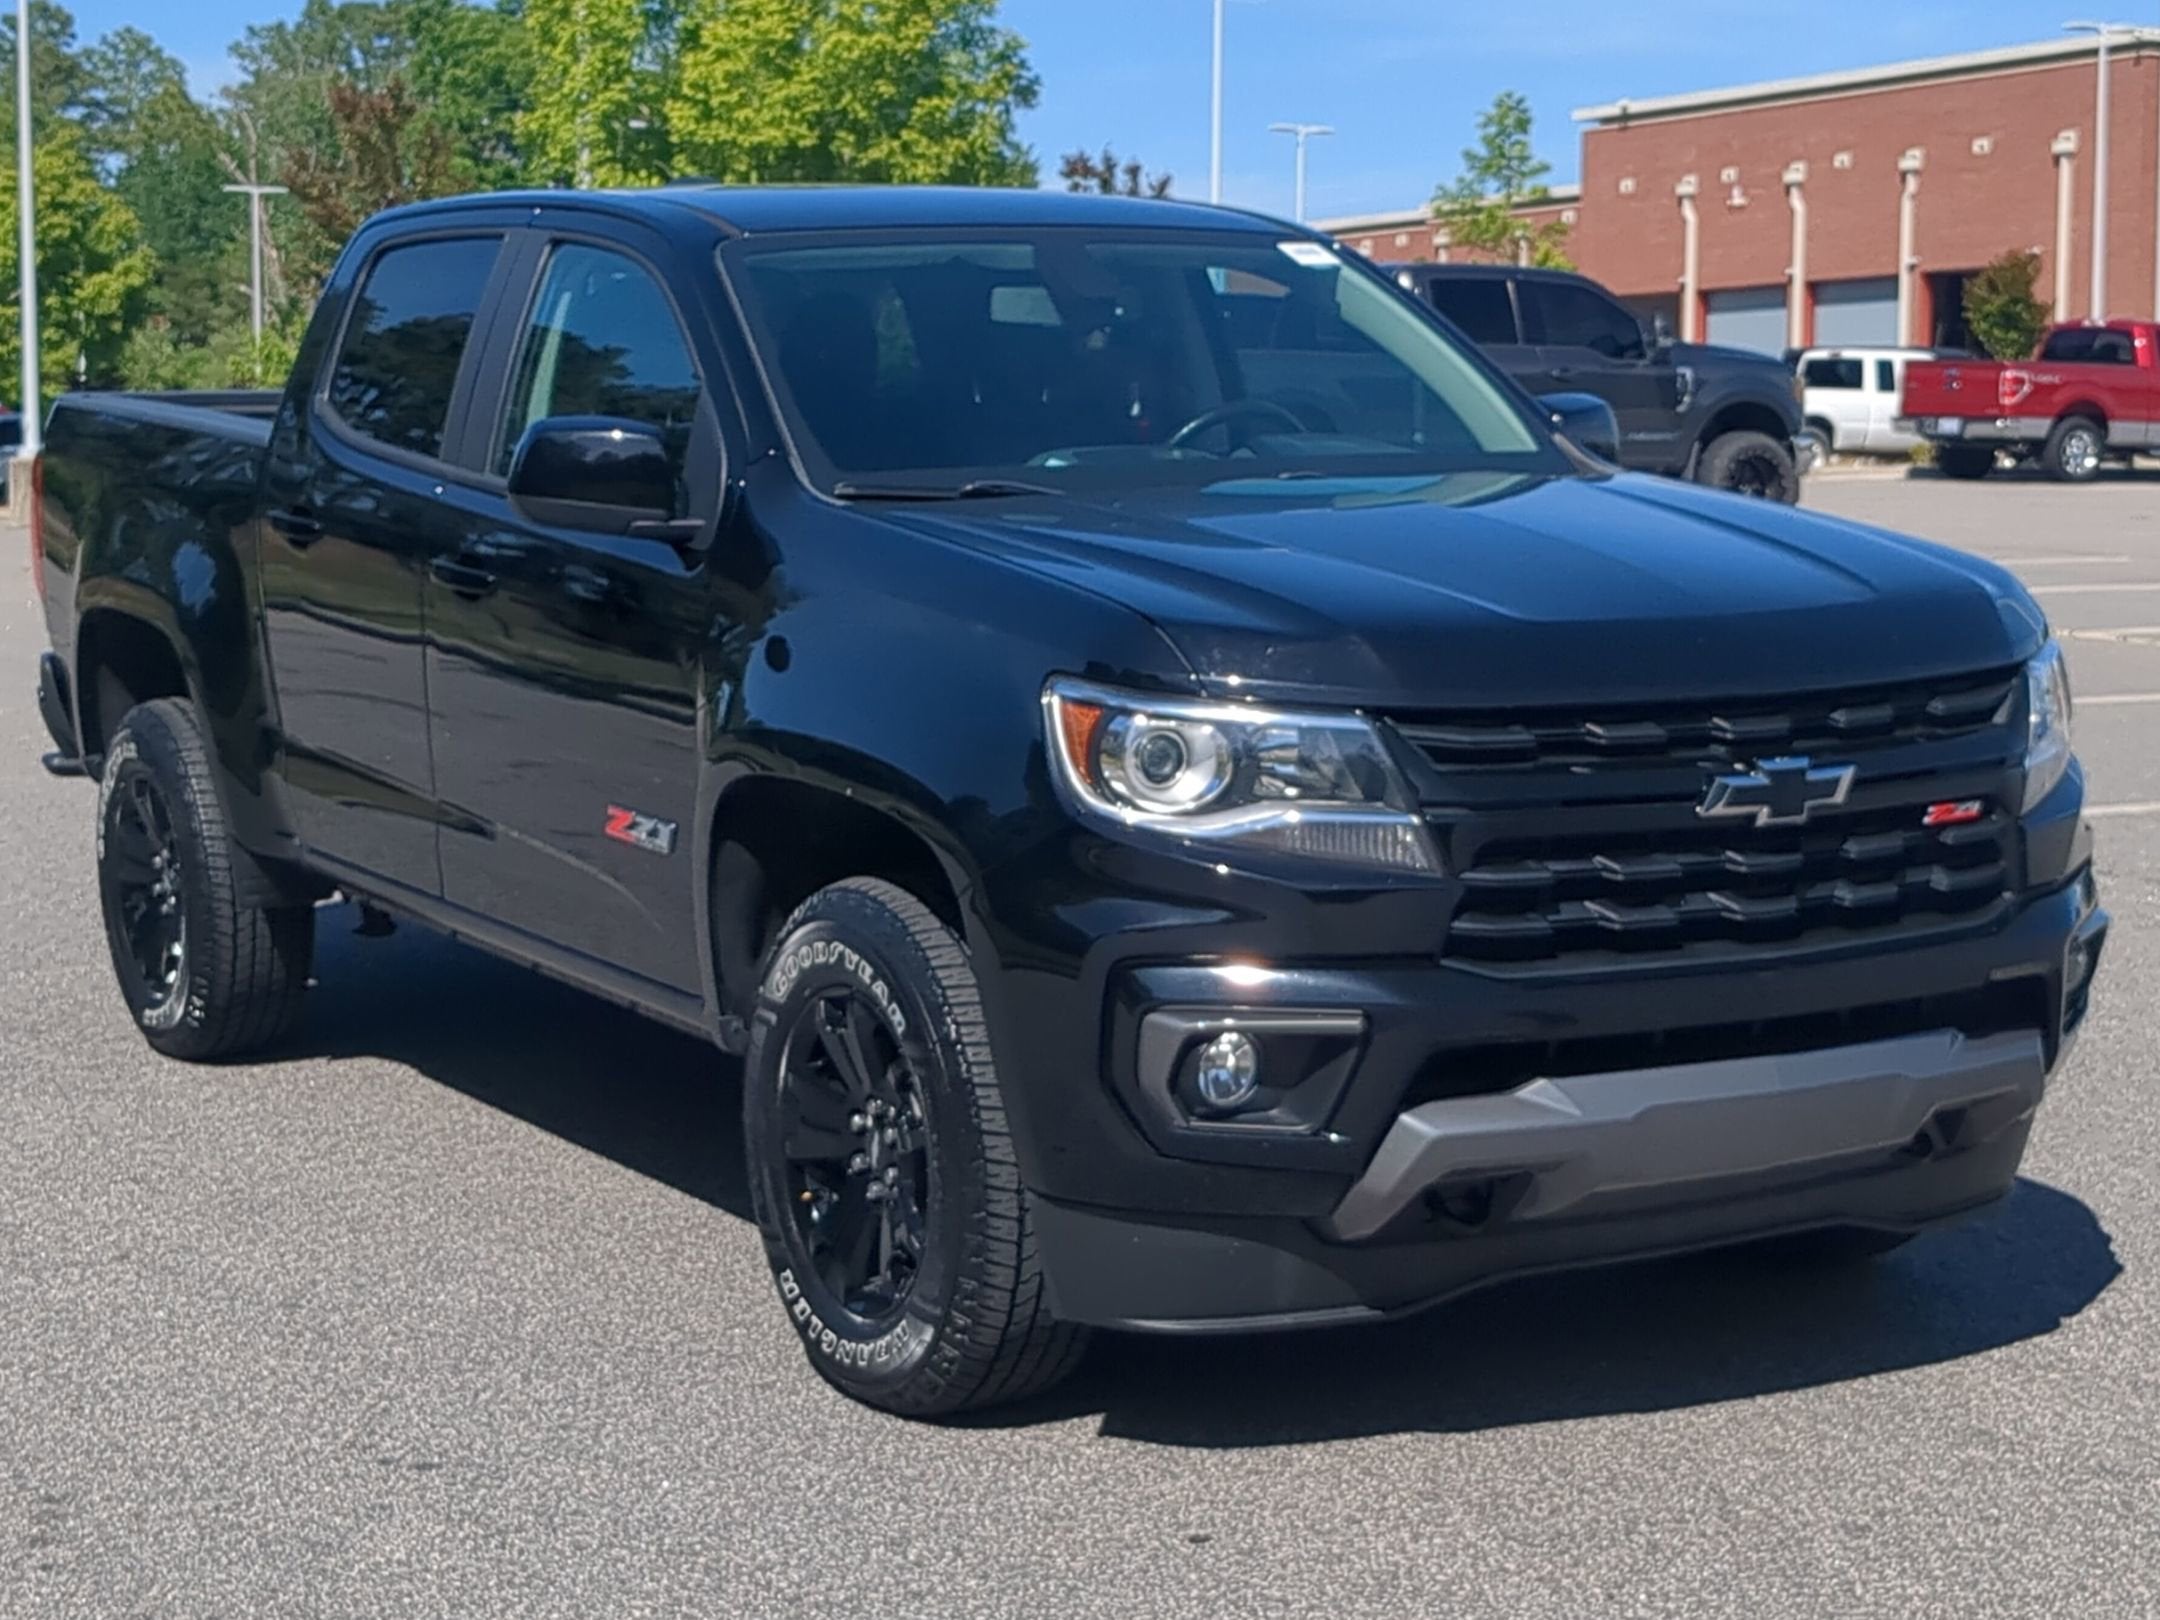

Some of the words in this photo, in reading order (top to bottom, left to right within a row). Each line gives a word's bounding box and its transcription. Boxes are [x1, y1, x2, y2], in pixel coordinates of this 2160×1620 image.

[605, 803, 677, 854] Z71
[772, 940, 906, 1036] GOODYEAR
[779, 1268, 910, 1365] WRANGLER
